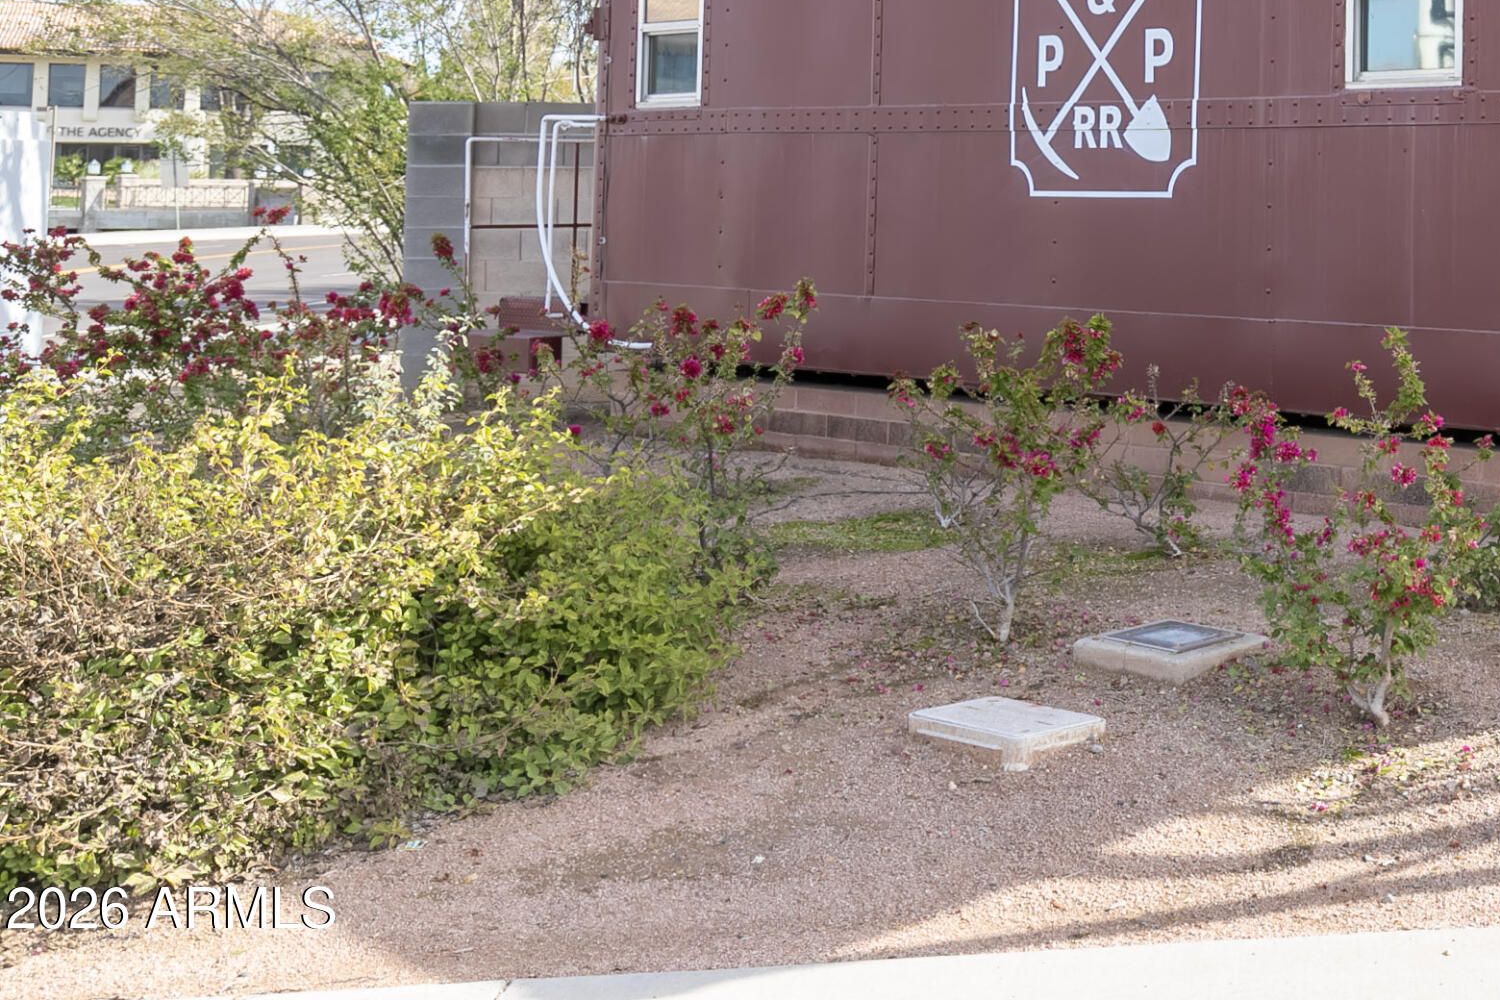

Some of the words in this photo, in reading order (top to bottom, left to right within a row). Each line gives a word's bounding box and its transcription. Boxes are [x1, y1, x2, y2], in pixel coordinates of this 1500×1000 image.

[1037, 34, 1064, 88] P
[1144, 27, 1174, 84] P
[59, 126, 85, 137] THE
[88, 127, 141, 138] AGENCY
[1072, 105, 1124, 149] RR
